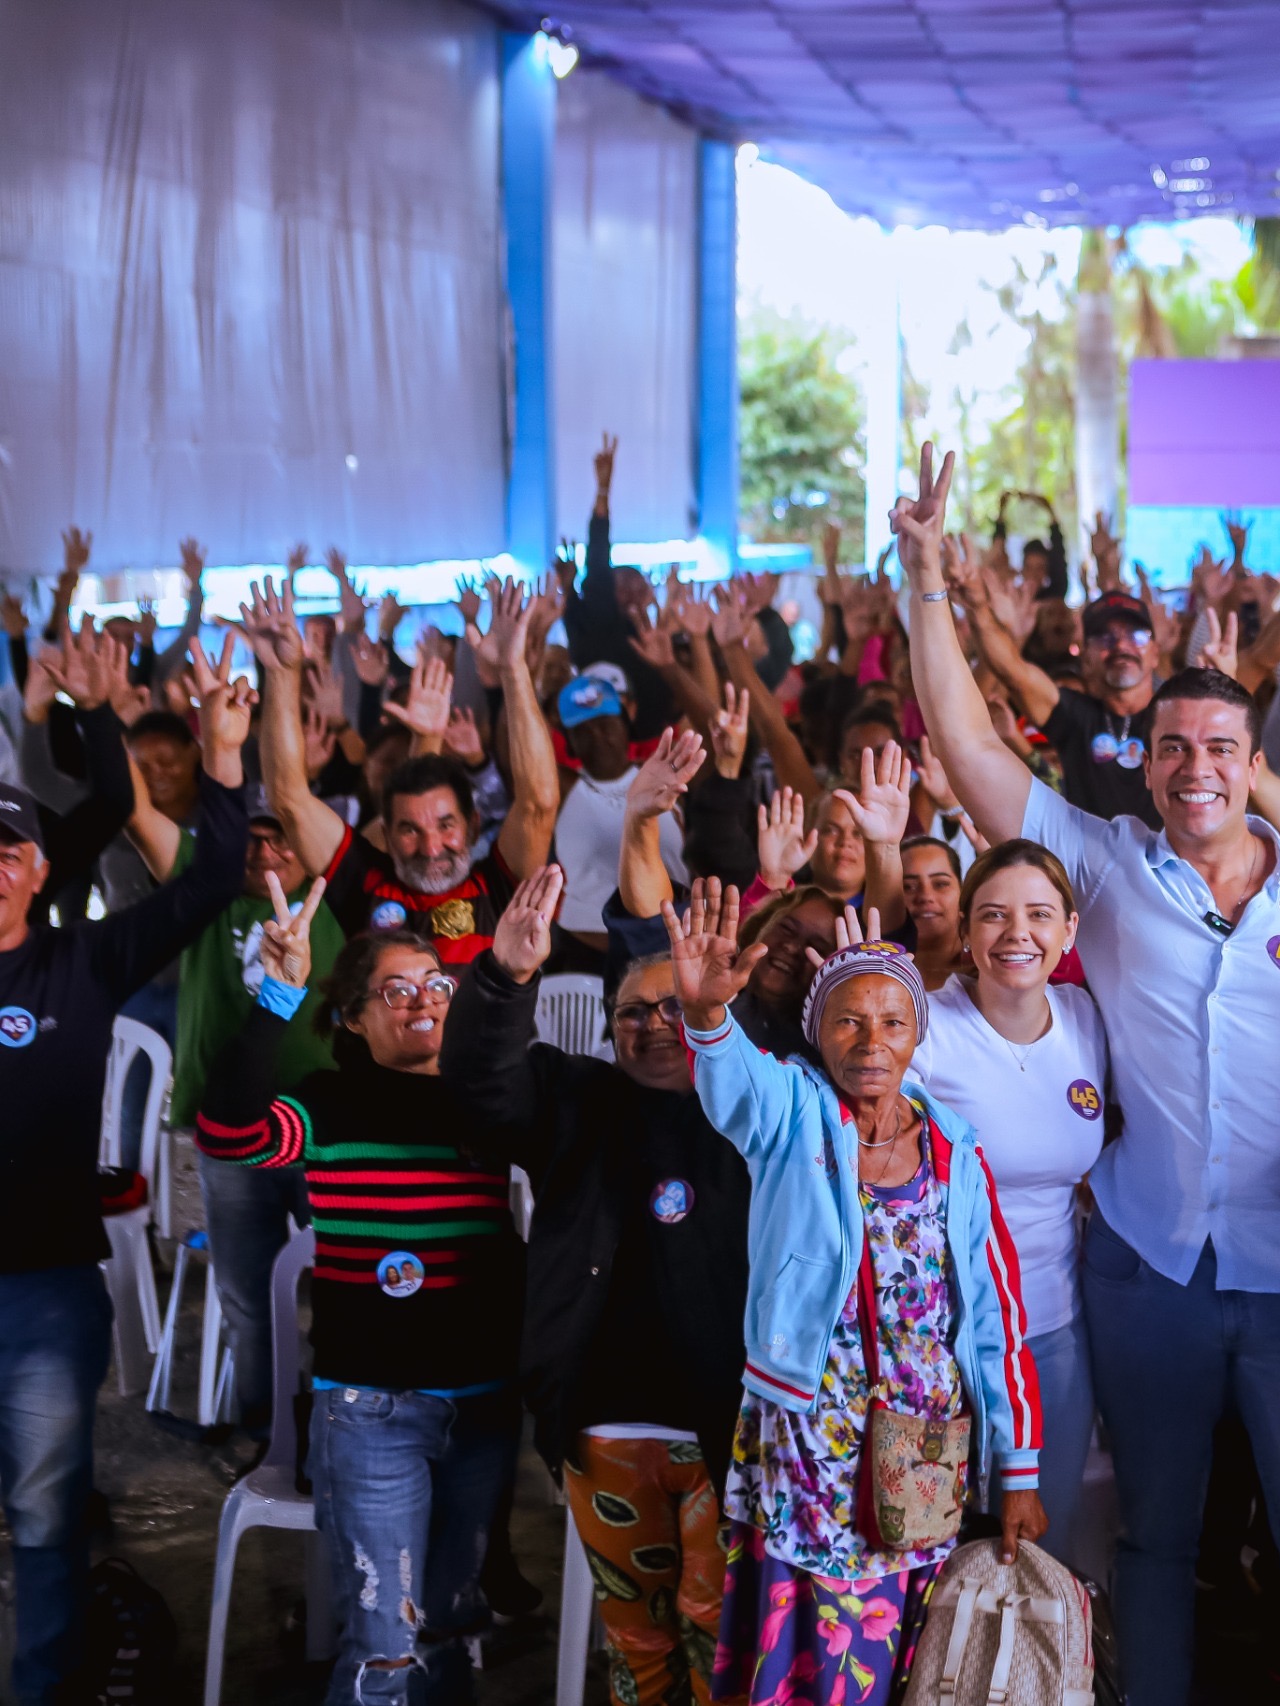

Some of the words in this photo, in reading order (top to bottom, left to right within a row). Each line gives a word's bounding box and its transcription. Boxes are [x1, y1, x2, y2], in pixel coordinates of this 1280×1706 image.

[860, 942, 899, 954] 45
[1, 1017, 29, 1033] 45
[1071, 1087, 1099, 1109] 45
